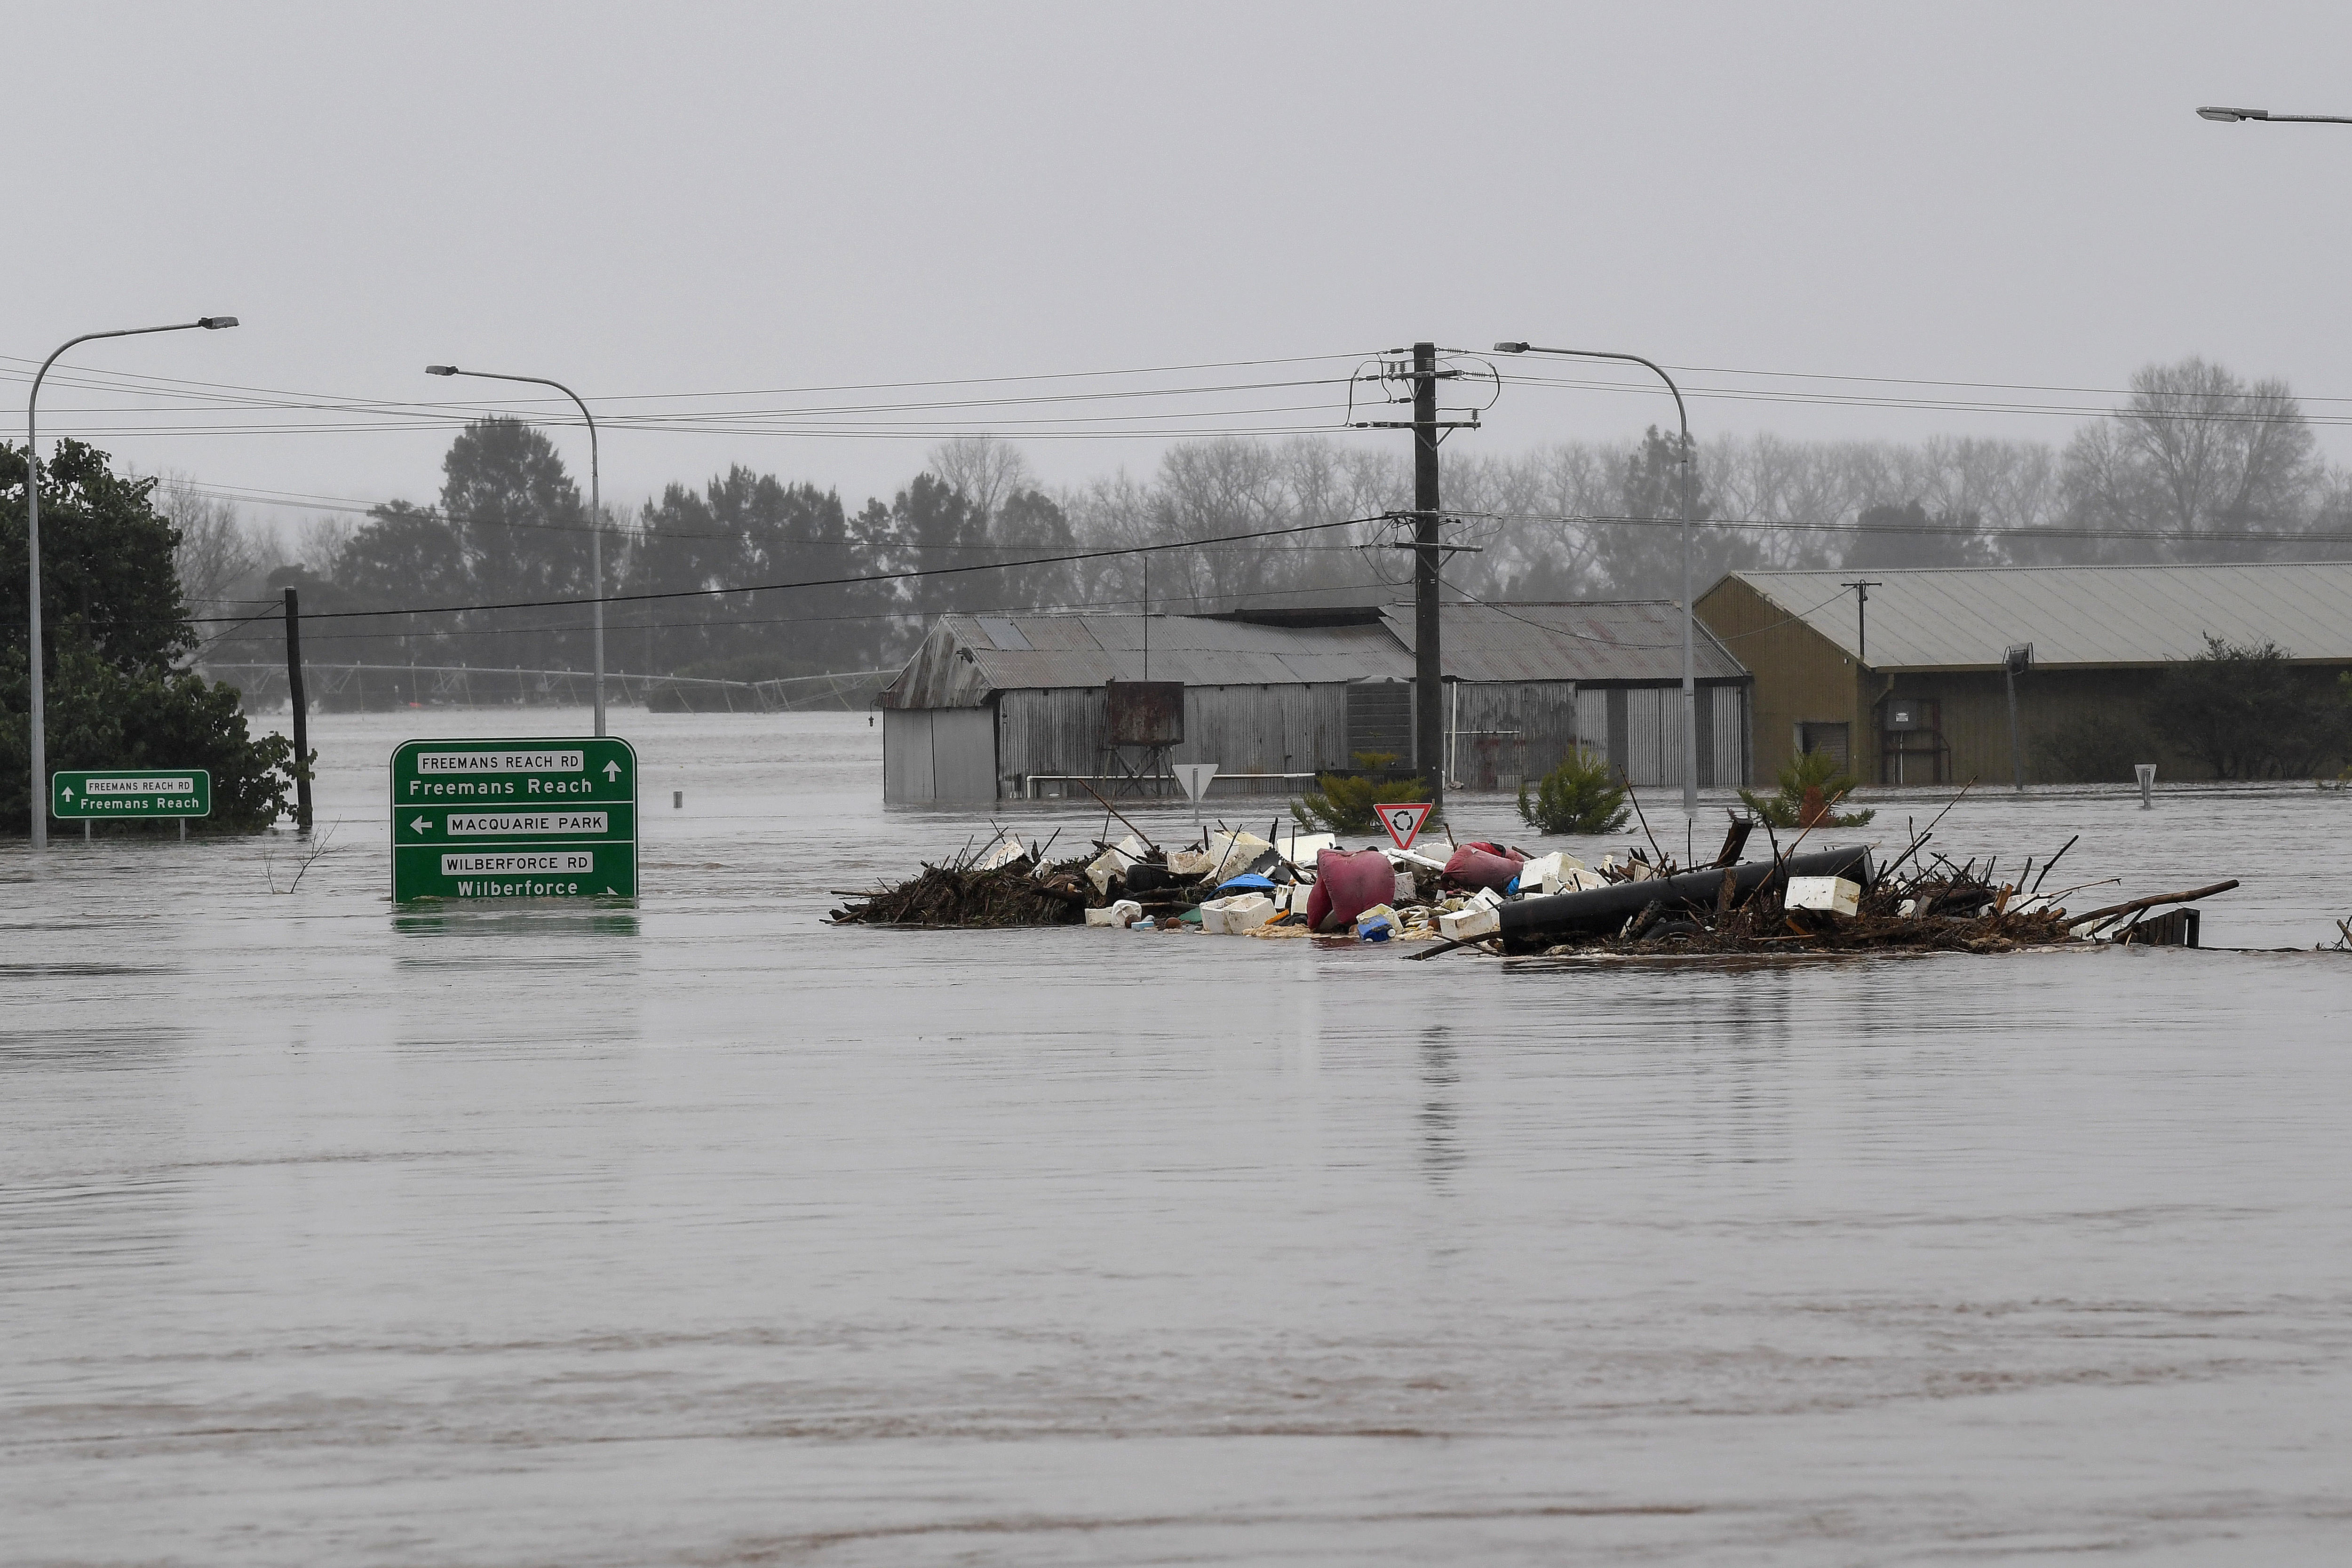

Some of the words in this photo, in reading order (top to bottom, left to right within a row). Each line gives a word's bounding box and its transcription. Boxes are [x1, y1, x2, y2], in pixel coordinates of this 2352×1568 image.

[423, 756, 498, 769] FREEMANS
[506, 756, 552, 768] REACH
[561, 756, 578, 767] RD
[89, 782, 138, 791] FREEMANS
[143, 781, 173, 790] REACH
[178, 781, 190, 790] RD
[410, 780, 514, 795] Freemans
[528, 778, 592, 793] Reach
[81, 798, 149, 809] Freemans
[157, 797, 199, 808] Reach
[452, 818, 549, 830] MACQUARIE
[559, 817, 602, 829] PARK
[446, 857, 558, 870] WILBERFORCE
[568, 857, 588, 868] RD
[457, 880, 578, 896] Wilberforce
